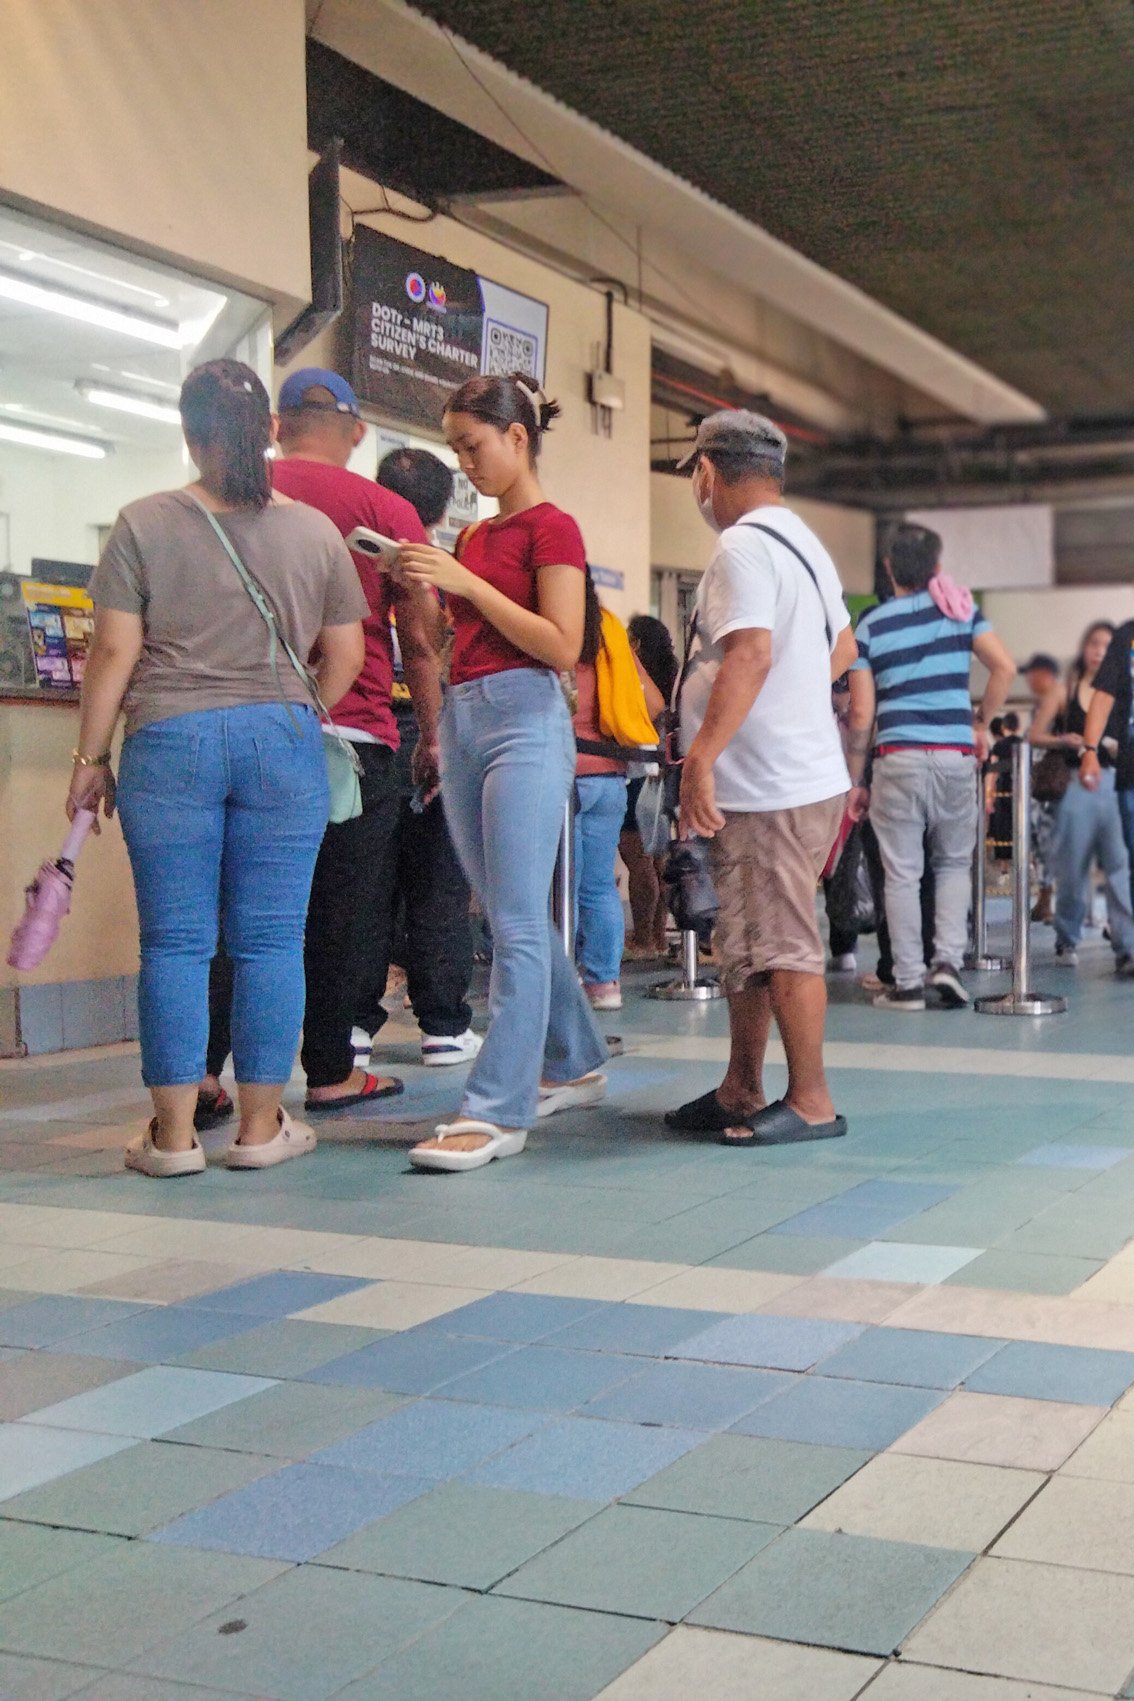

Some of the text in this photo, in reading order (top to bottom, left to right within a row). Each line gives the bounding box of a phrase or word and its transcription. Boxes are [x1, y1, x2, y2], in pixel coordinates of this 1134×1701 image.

[412, 317, 444, 340] MRT3
[370, 333, 417, 360] SURVEY
[371, 318, 479, 368] CITIZEN'S CHARTER
